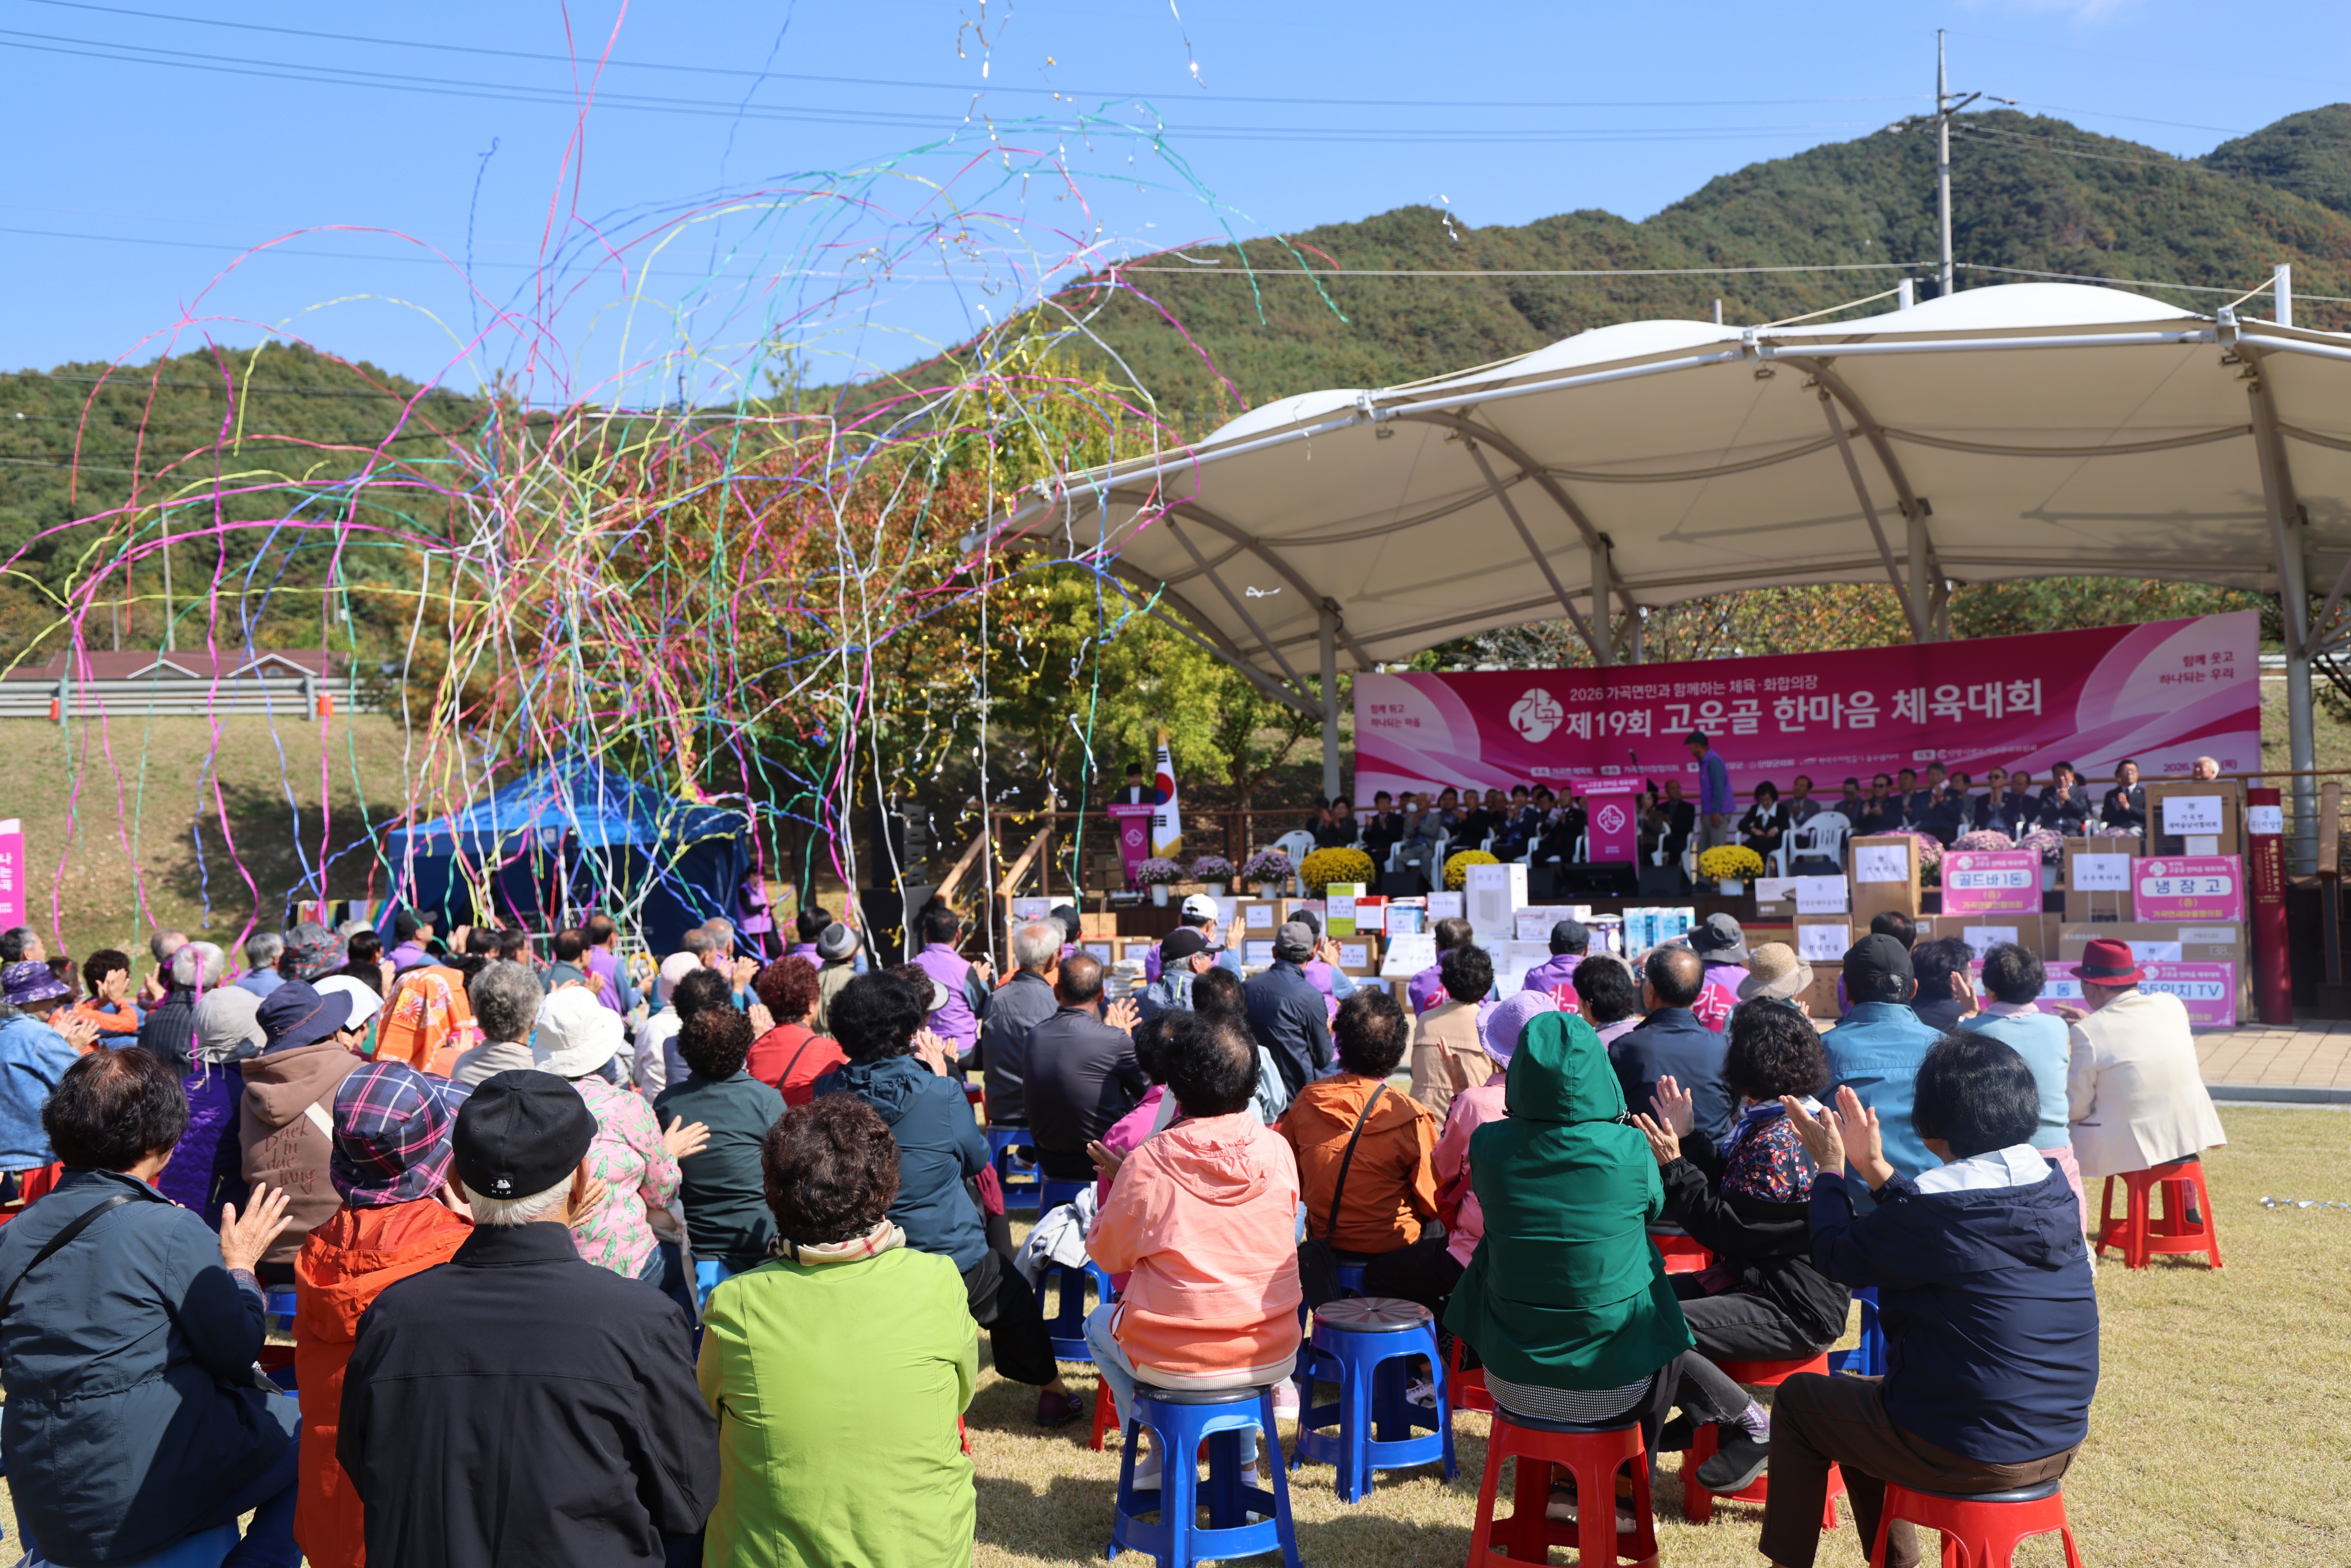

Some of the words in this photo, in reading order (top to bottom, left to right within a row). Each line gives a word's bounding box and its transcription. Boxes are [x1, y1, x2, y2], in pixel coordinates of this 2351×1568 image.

[2182, 653, 2206, 668] 함께
[2210, 651, 2234, 664] 웃고
[2159, 670, 2206, 685] 하나되는
[2210, 667, 2234, 680] 우리
[1569, 687, 1604, 701] 2026
[1606, 684, 1671, 701] 가곡면민과
[1673, 681, 1725, 698] 함께하는
[1371, 703, 1387, 715] 함께
[1565, 708, 1652, 740] 제19회
[1660, 698, 1763, 736] 고운골
[1772, 690, 1880, 733] 한마음
[1891, 677, 2042, 724] 체육대회
[2196, 984, 2221, 997] TV
[283, 1140, 298, 1155] in
[267, 1148, 298, 1171] dae
